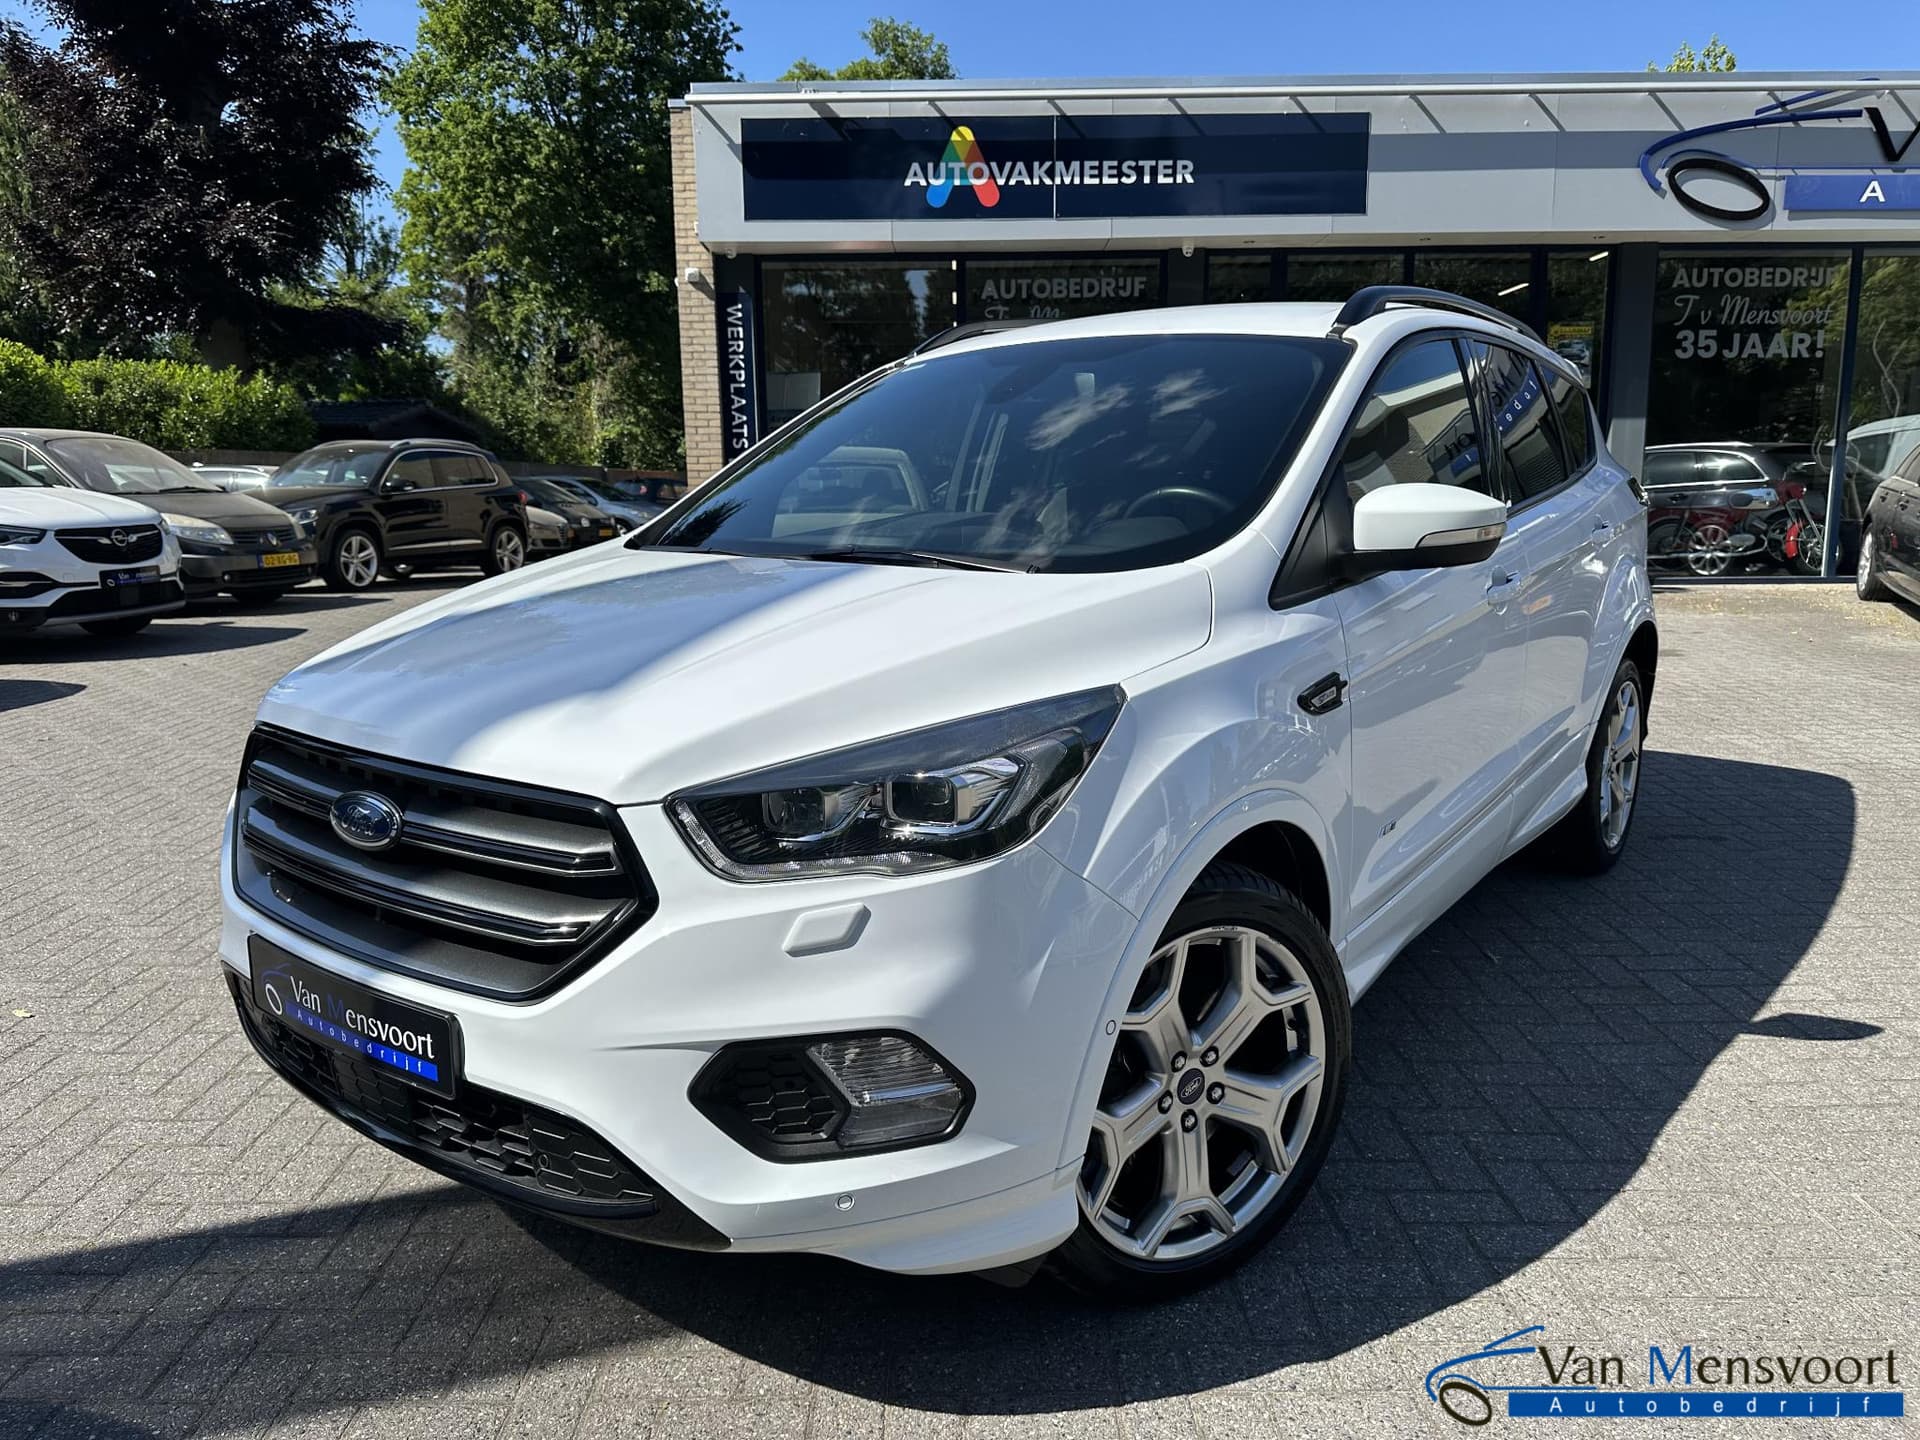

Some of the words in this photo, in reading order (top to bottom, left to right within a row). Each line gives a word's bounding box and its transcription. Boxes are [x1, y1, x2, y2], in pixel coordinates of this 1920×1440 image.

[904, 160, 1195, 187] AUTOVAKMEESTER
[981, 276, 1147, 299] AUTOBEDRIJF
[1672, 267, 1838, 288] AUTOBEDRIJF
[1720, 294, 1833, 326] Mensvoort
[1674, 329, 1718, 359] 35
[1722, 329, 1825, 359] JAAR!
[726, 303, 749, 449] WERKPLAATS
[290, 975, 321, 1013] Van
[327, 994, 435, 1059] Mensvoort
[297, 1009, 422, 1072] Autobedrijf
